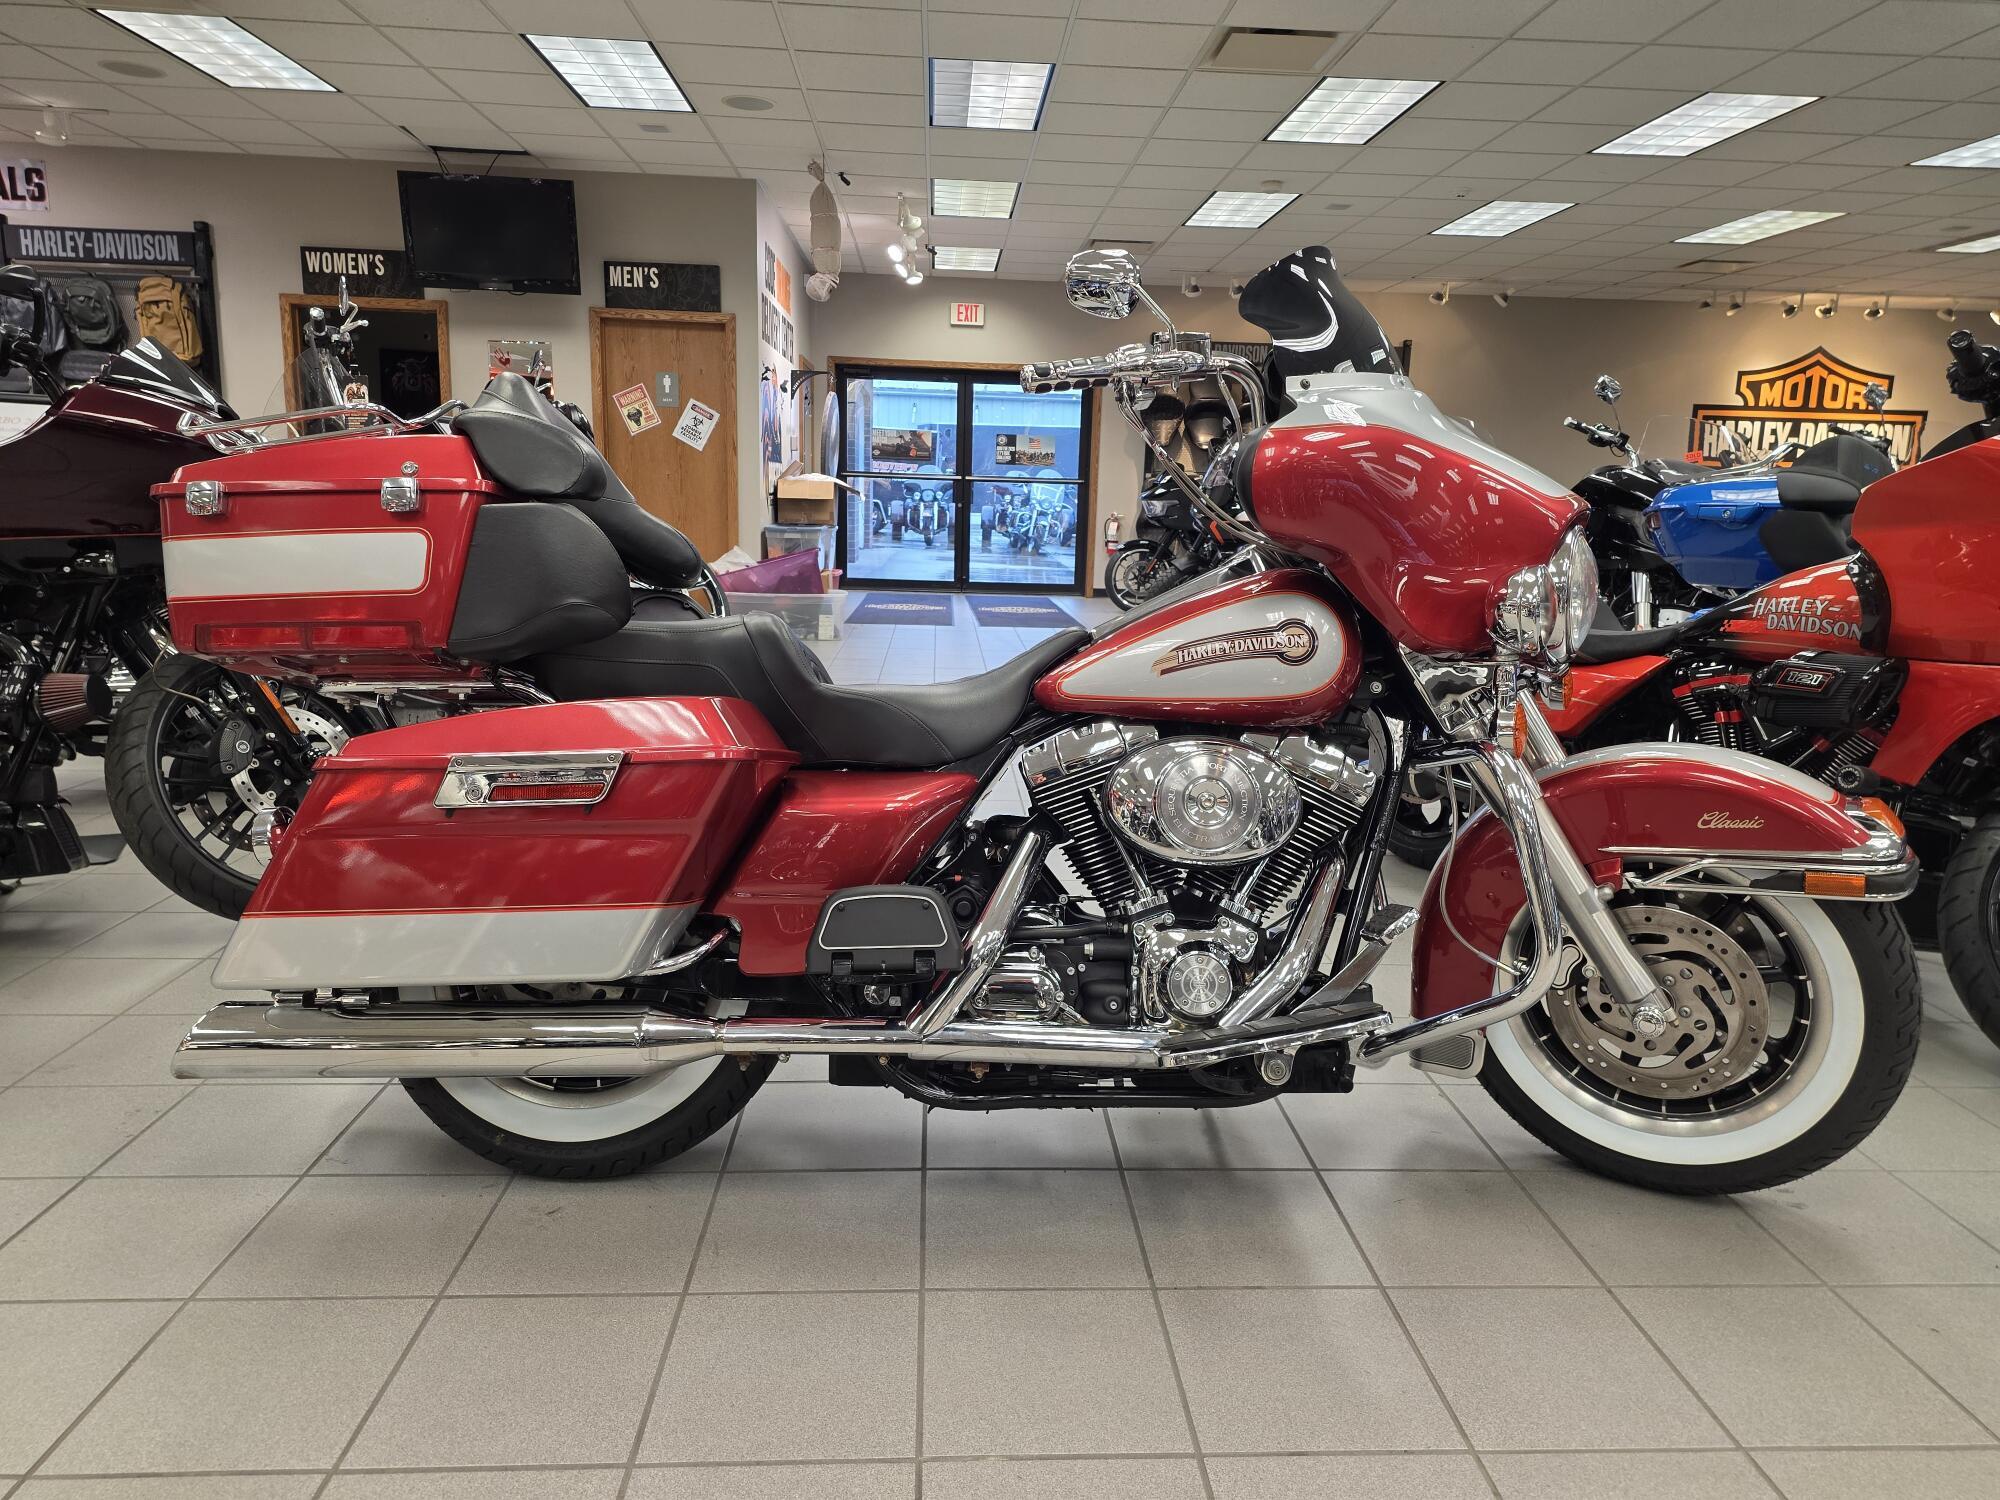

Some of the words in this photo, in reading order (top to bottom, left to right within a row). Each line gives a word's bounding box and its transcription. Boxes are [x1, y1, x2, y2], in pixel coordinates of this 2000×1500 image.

[19, 228, 181, 262] HARLEY-DAVIDSON
[305, 250, 386, 276] WOMEN'S
[609, 265, 660, 289] MEN'S
[957, 303, 980, 323] EXIT
[1753, 597, 1841, 618] HARLEY-
[1767, 614, 1861, 640] DAVIDSON
[1176, 633, 1306, 664] HARLEY-DAVIDSON
[1786, 671, 1823, 685] 121
[1697, 811, 1765, 829] Classic
